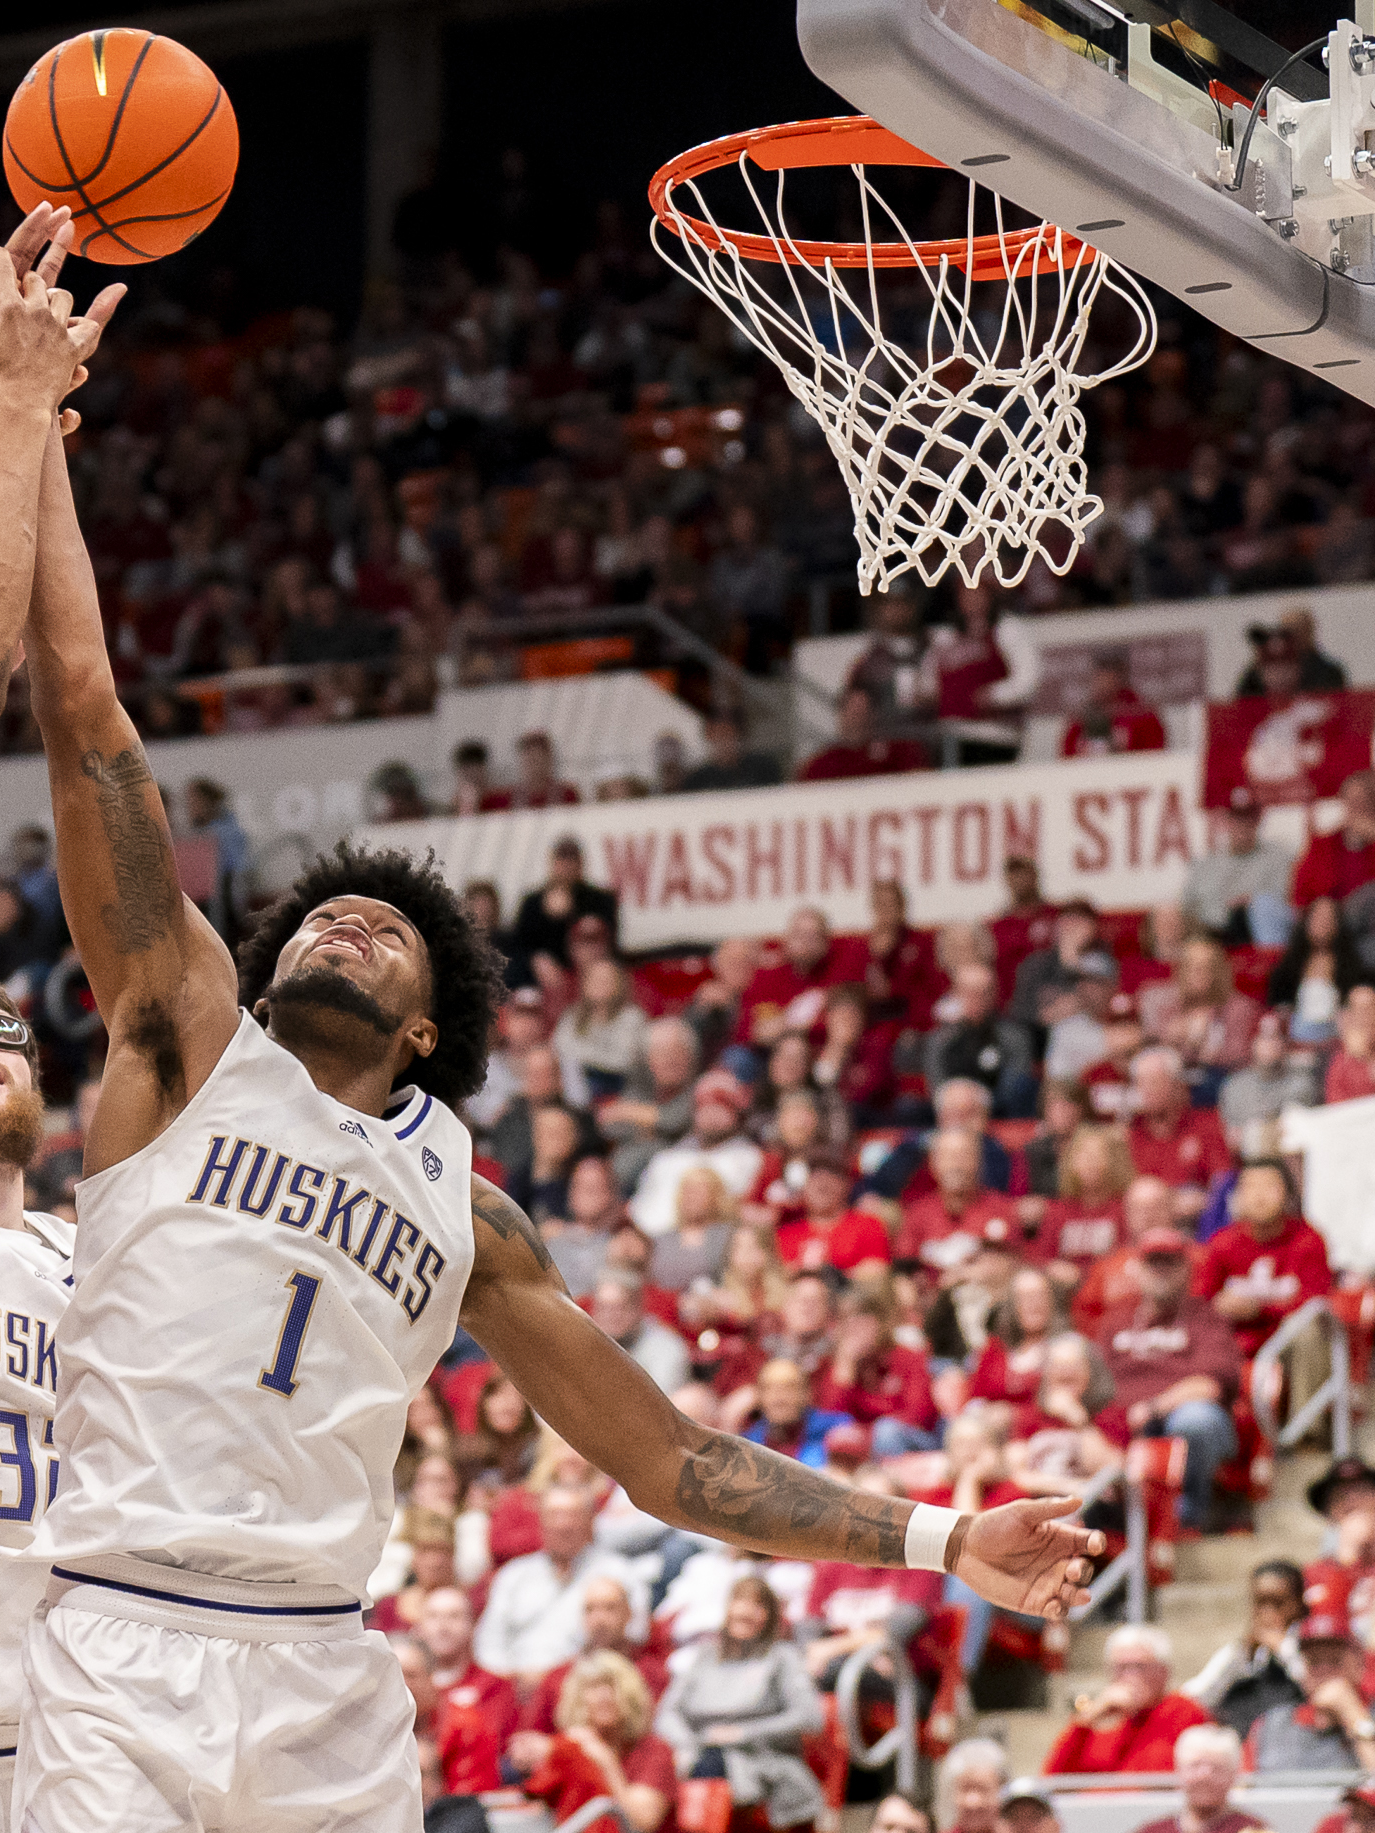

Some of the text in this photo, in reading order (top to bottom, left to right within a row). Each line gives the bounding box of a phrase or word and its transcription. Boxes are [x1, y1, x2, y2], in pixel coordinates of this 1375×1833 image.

[603, 797, 1040, 907] WASHINGTON
[185, 1134, 448, 1326] HUSKIES
[256, 1268, 324, 1399] 1
